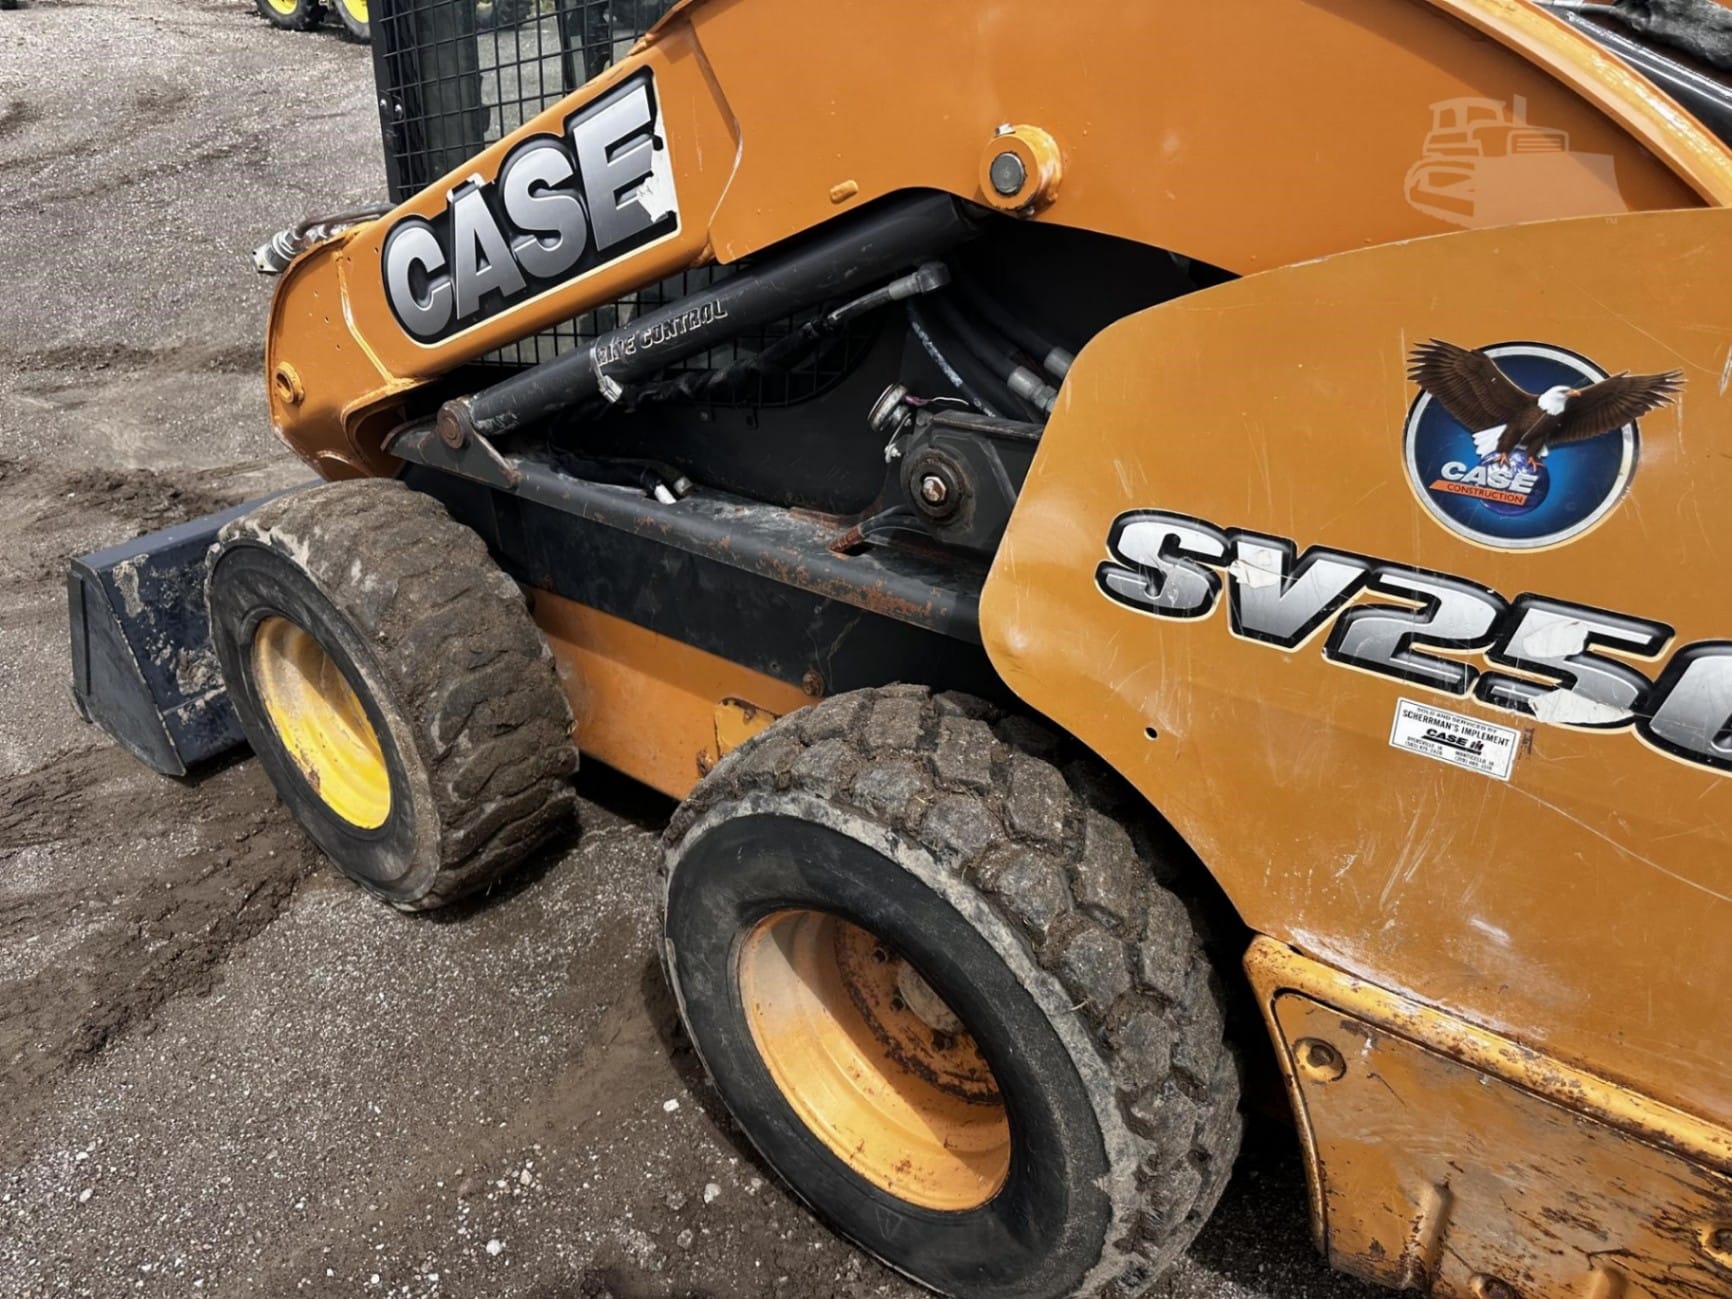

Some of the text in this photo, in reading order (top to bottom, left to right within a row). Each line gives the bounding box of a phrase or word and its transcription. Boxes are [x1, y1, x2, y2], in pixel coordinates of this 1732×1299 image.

[384, 68, 664, 338] CASE
[639, 299, 728, 350] CONTROL
[1440, 461, 1538, 493] CASE
[1447, 483, 1524, 504] CONSTRUCTION
[1402, 708, 1460, 733] SCHERRMAN'S
[1461, 725, 1511, 747] IMPLEMENT
[1426, 728, 1469, 747] CASE
